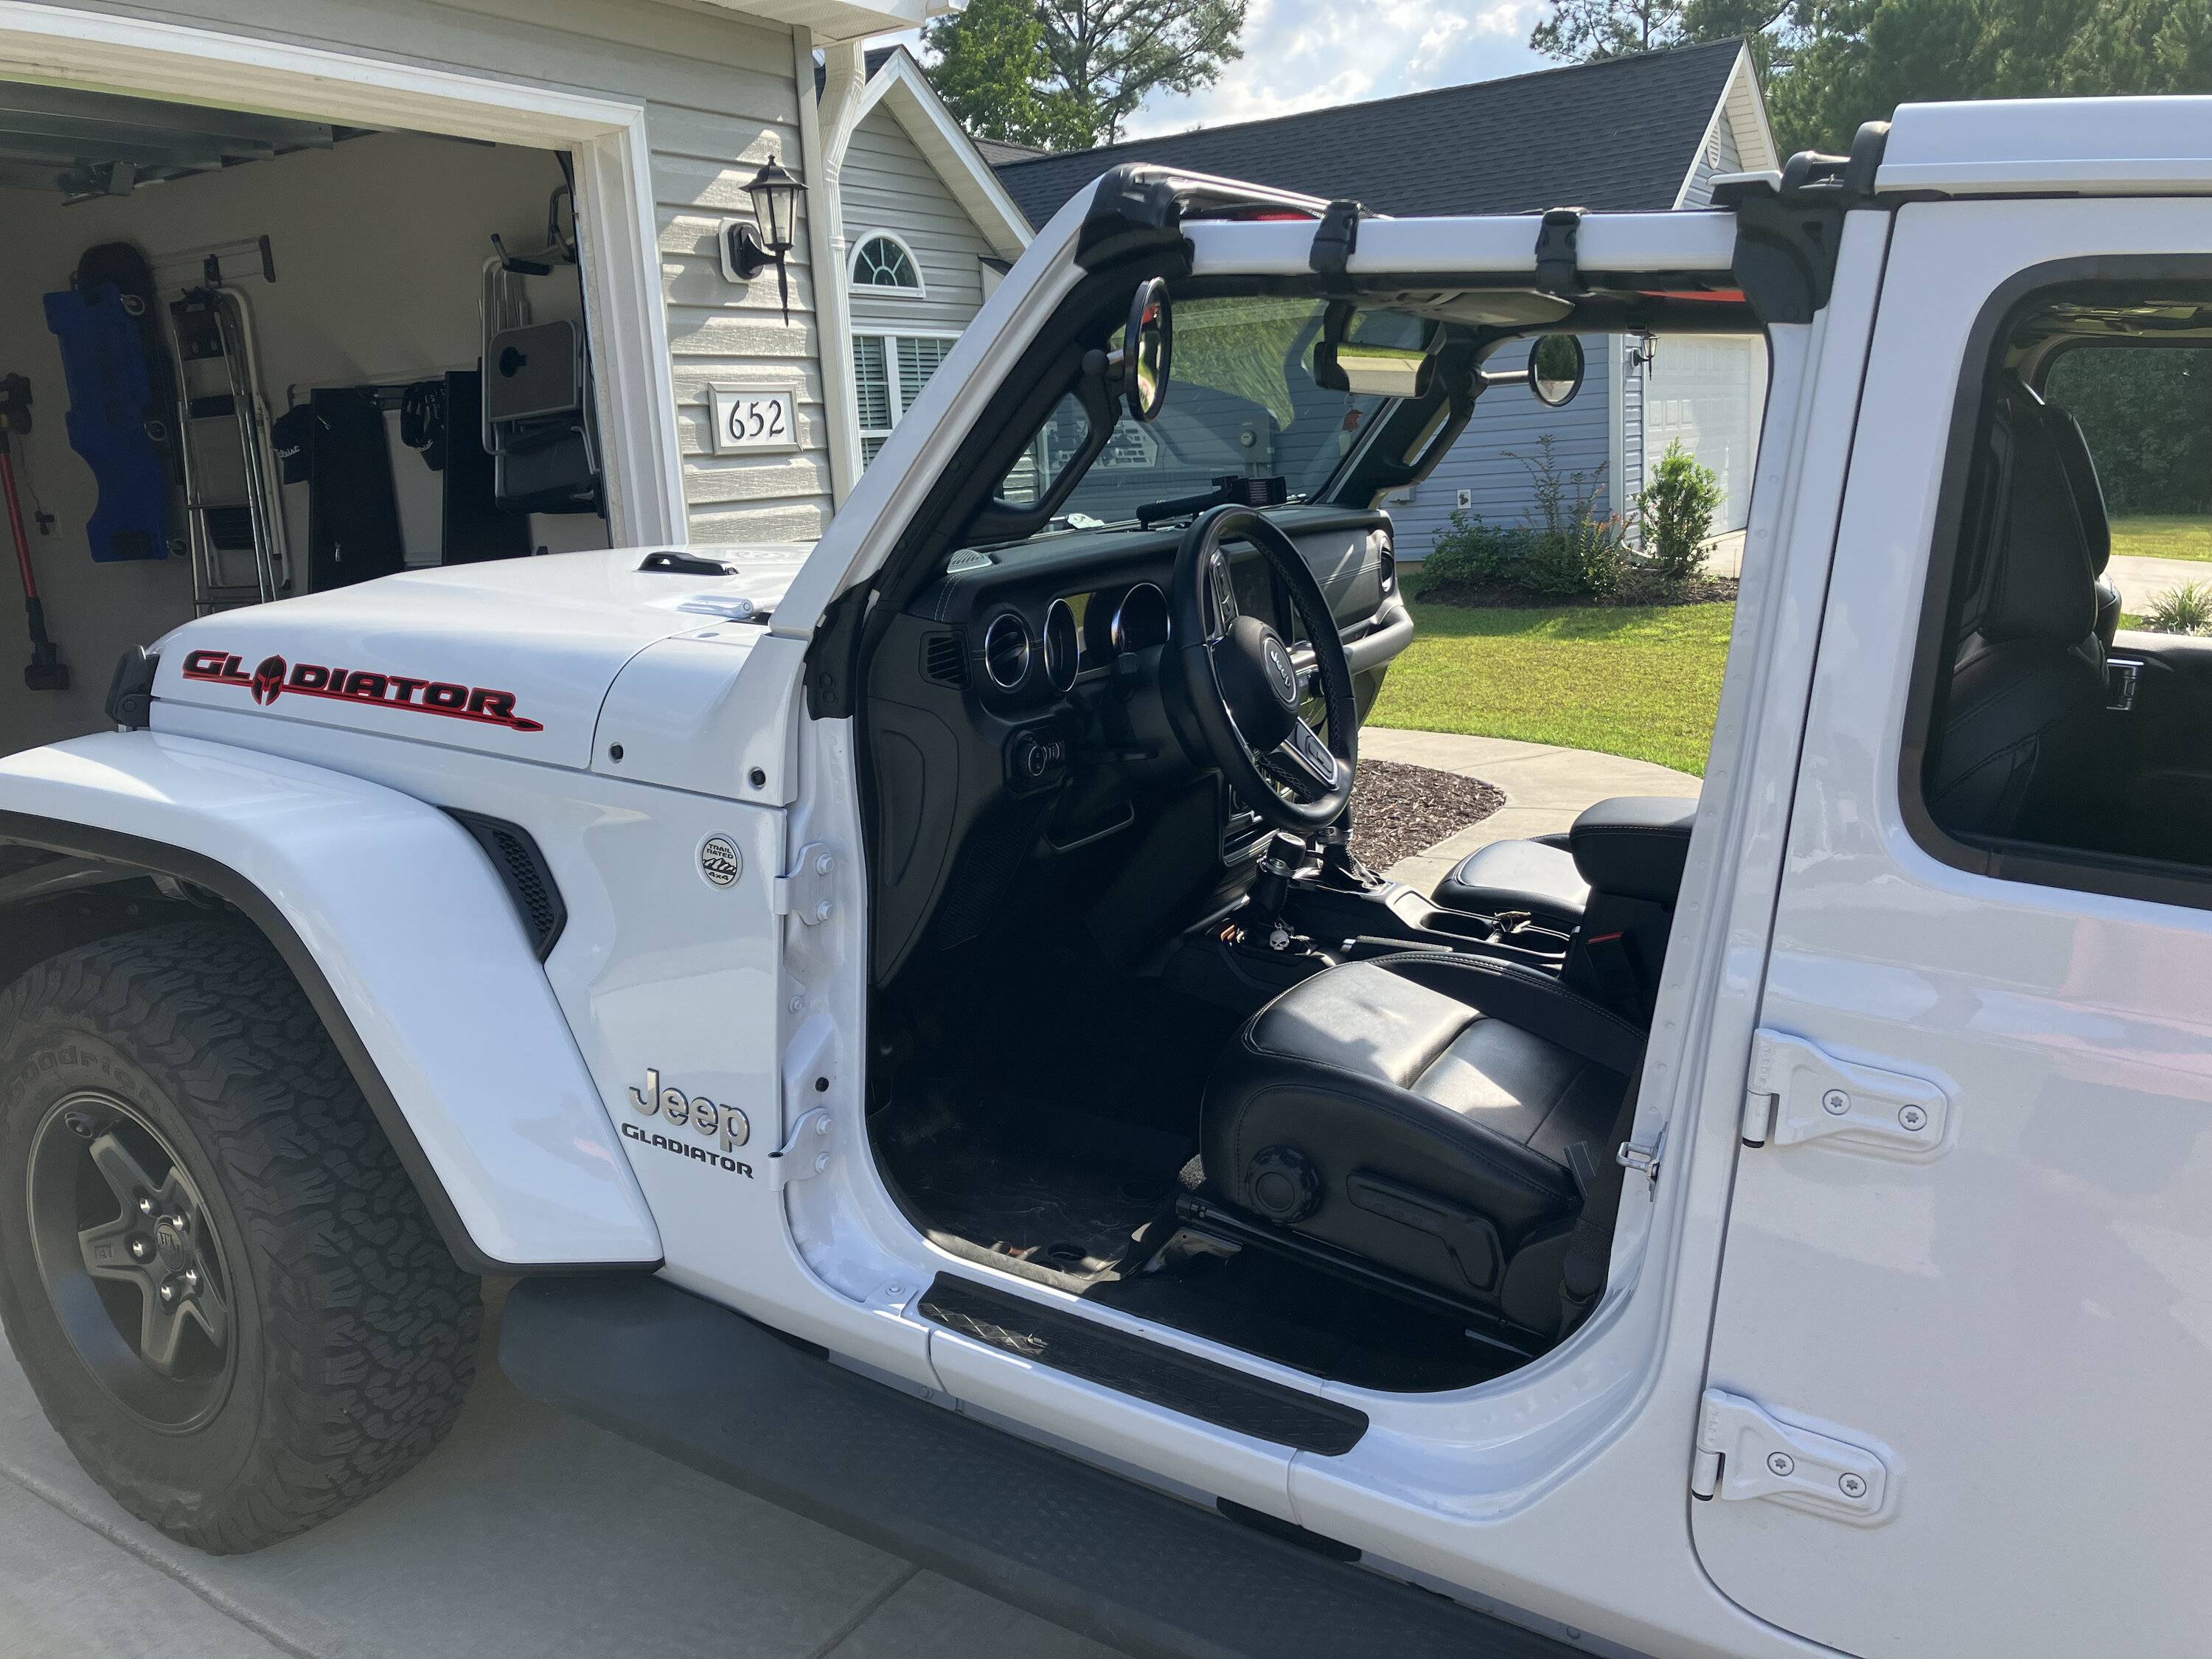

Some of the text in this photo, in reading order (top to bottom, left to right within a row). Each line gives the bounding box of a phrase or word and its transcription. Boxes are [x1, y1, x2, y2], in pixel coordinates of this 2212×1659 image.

[729, 400, 785, 440] 652
[706, 849, 734, 860] RATED
[709, 844, 732, 854] TRAIL
[628, 1068, 751, 1153] Jeep
[621, 1122, 754, 1180] GLADIATOR
